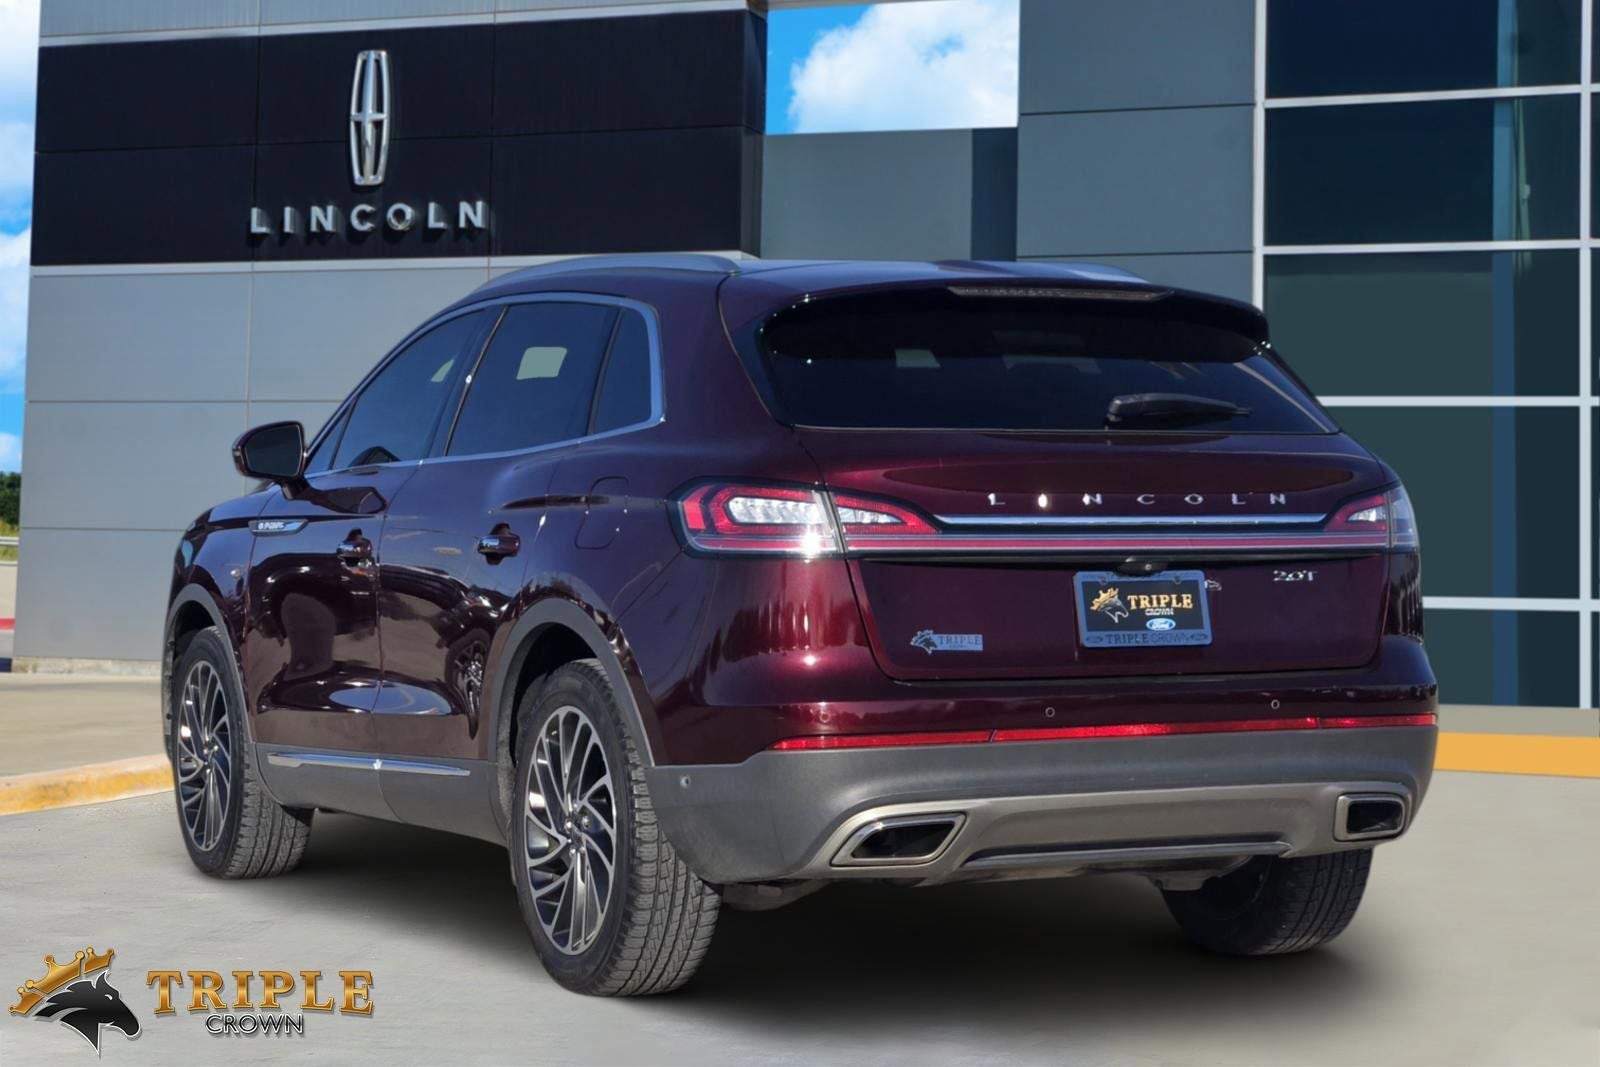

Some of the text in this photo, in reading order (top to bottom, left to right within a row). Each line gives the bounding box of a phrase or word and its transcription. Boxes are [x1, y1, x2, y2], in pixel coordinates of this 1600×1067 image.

[250, 202, 487, 233] LINCOLN
[988, 492, 1287, 508] LINCOLN
[1127, 593, 1193, 609] TRIPLE
[1105, 632, 1148, 645] TRIPLE
